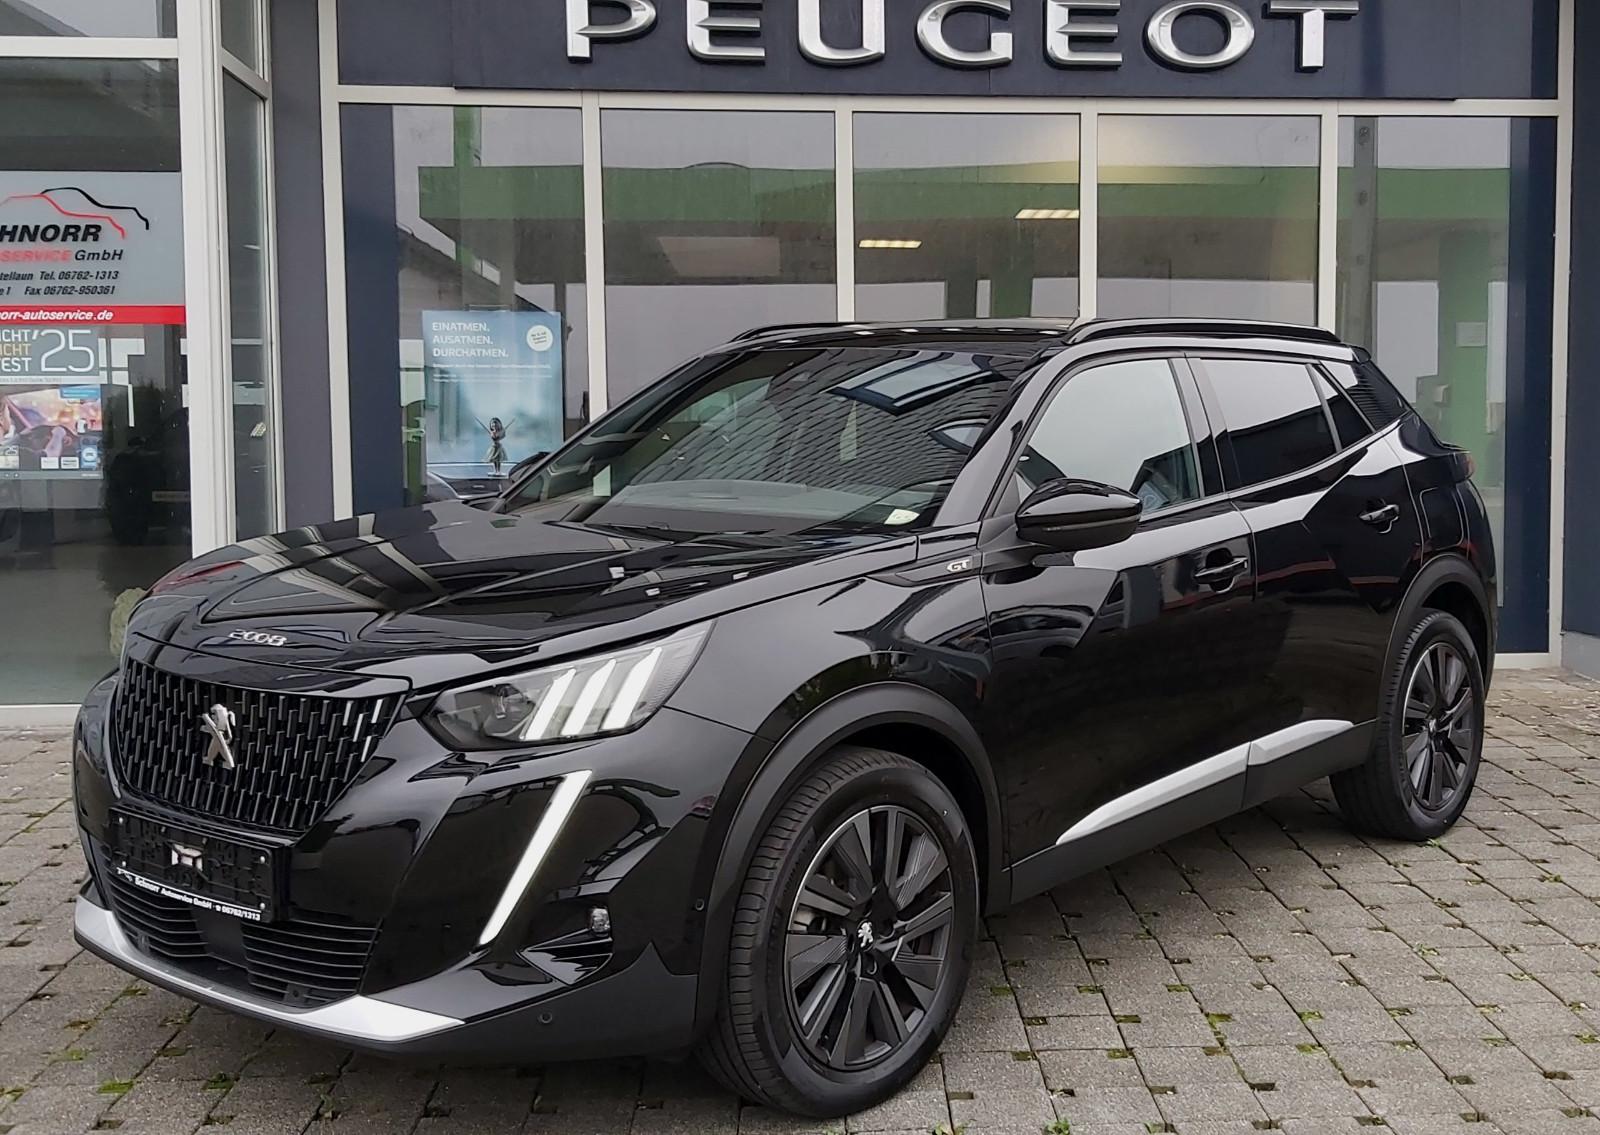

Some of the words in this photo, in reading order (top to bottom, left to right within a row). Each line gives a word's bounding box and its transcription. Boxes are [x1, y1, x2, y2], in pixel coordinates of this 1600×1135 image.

[565, 0, 1359, 68] PEUGEOT
[75, 249, 124, 261] GmbH
[40, 271, 56, 280] Tel.
[58, 270, 119, 280] 06762-1313
[24, 286, 42, 295] Fax
[432, 322, 490, 332] EINATMEN.
[432, 335, 493, 345] AUSATMEN.
[433, 348, 509, 357] DURCHATMEN.
[946, 559, 970, 572] GT
[228, 628, 288, 647] 2008
